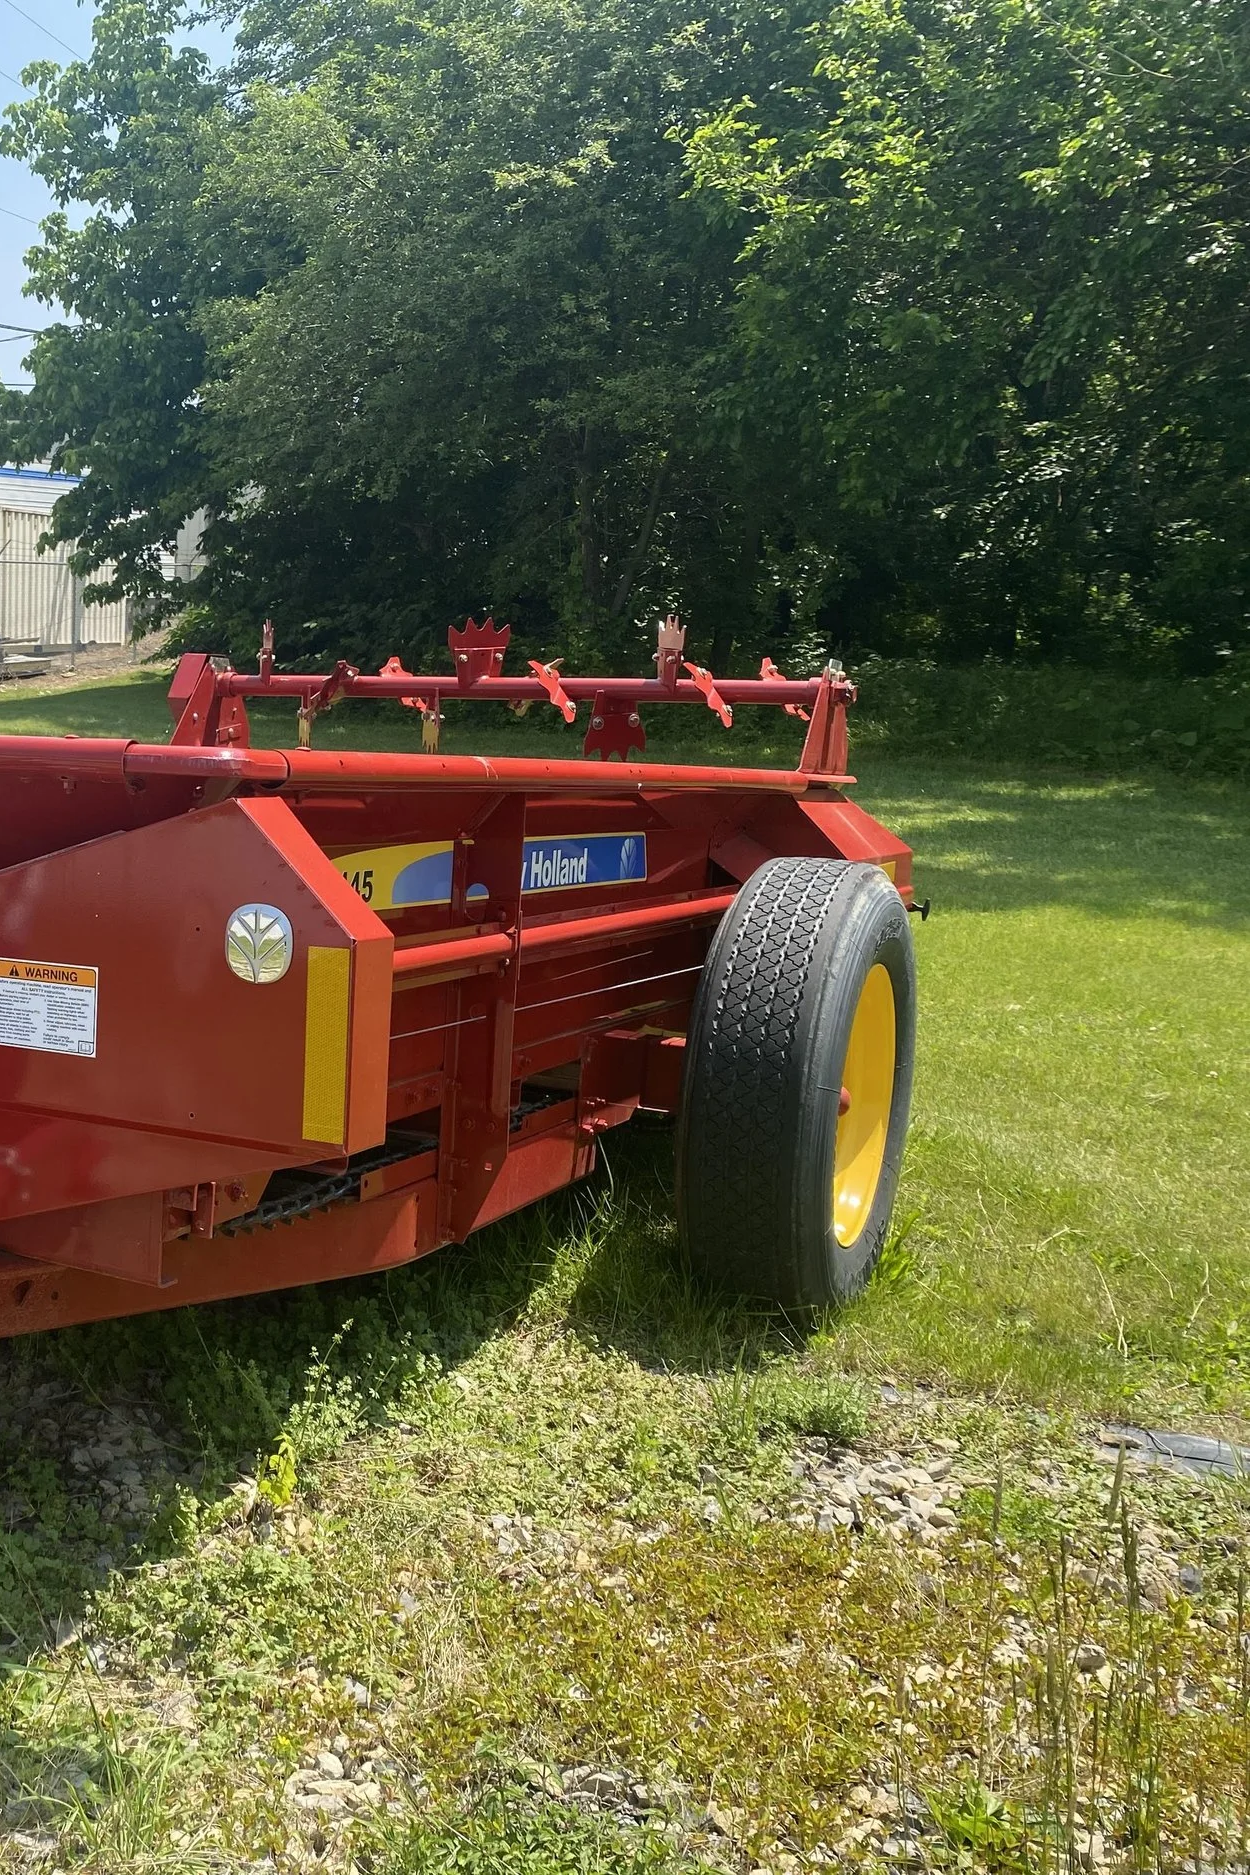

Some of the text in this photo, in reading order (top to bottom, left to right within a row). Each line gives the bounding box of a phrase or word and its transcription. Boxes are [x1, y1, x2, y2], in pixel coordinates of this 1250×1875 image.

[530, 847, 588, 888] Holland
[342, 870, 374, 903] 45
[25, 966, 78, 982] WARNING
